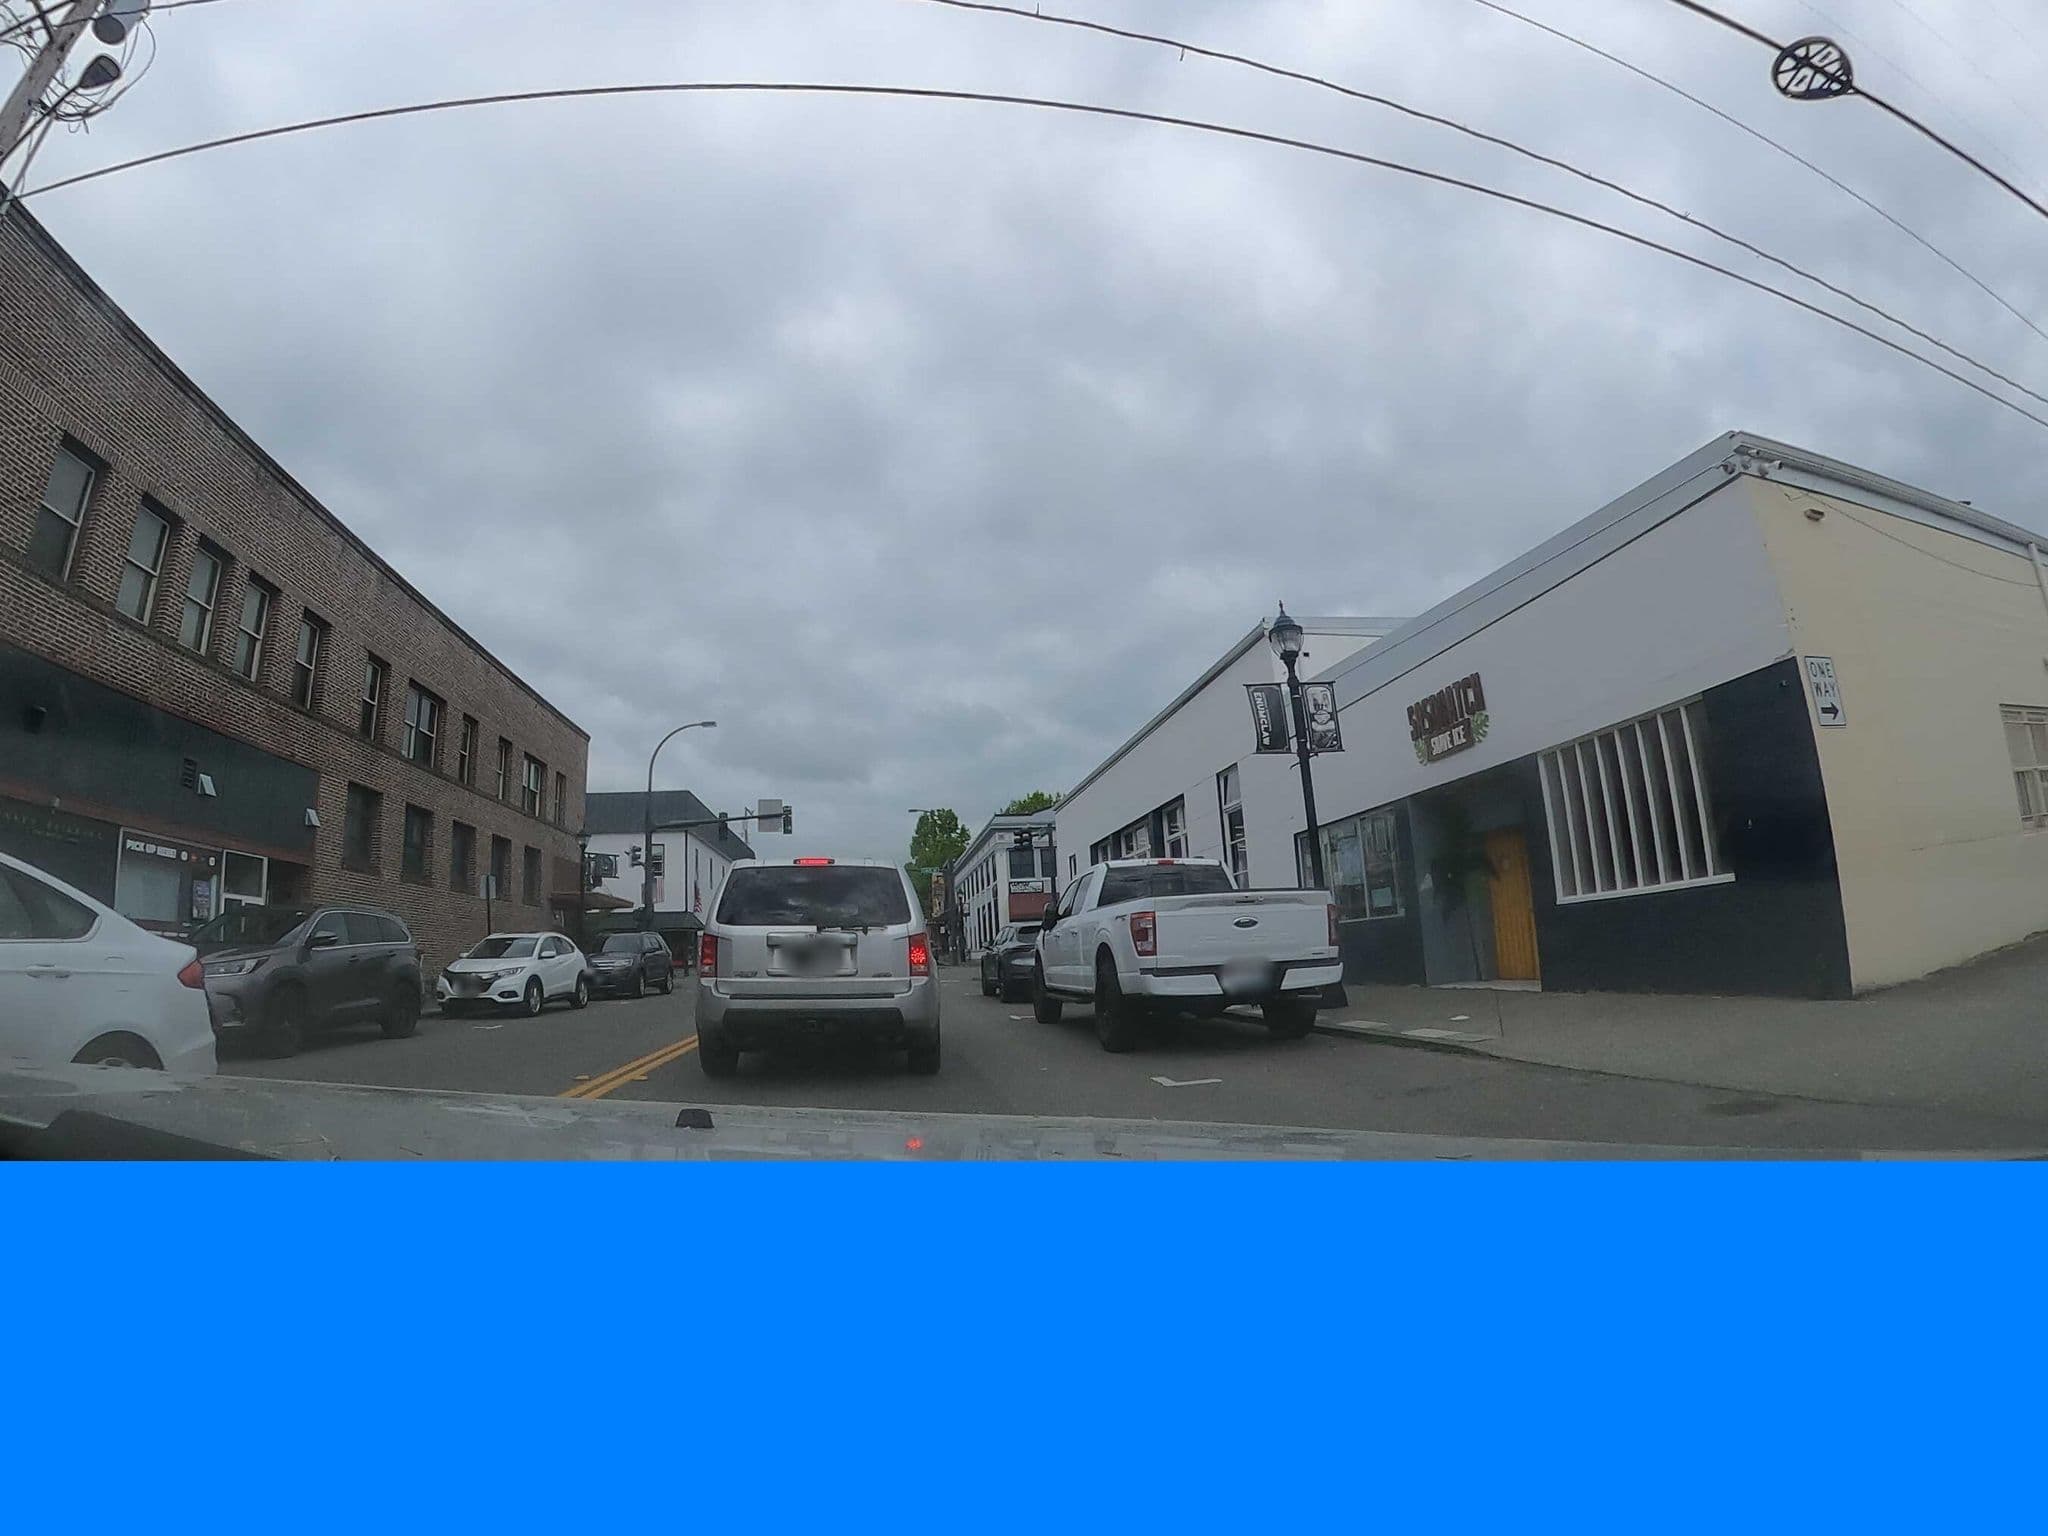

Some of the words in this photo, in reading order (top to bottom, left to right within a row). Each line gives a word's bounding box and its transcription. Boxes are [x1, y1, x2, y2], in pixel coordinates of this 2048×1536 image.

[1810, 661, 1833, 678] ONE
[1813, 681, 1836, 697] WAY
[1253, 692, 1271, 746] ENUMCLAW
